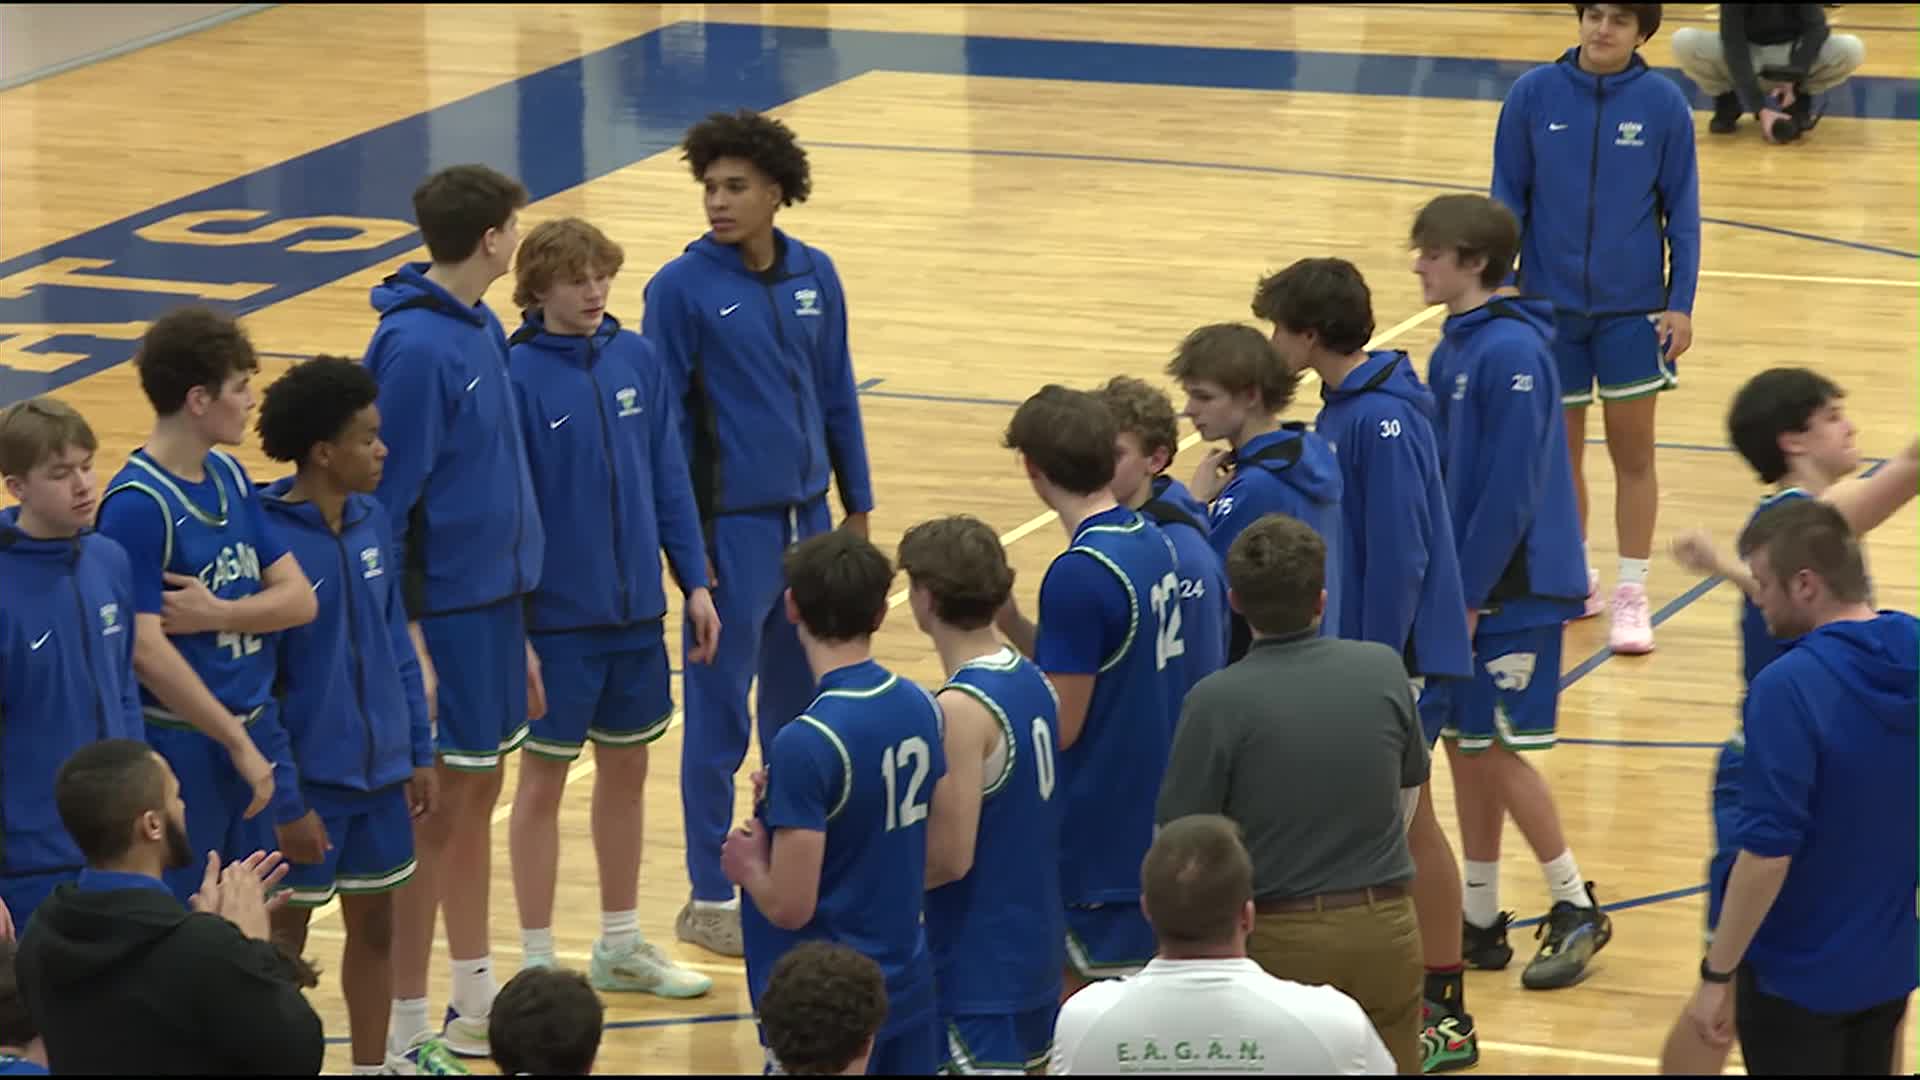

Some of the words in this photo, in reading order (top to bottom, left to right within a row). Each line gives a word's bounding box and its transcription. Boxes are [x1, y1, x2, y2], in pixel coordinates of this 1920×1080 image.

[1380, 419, 1401, 437] 30
[1180, 579, 1205, 598] 24
[882, 736, 930, 831] 12
[1032, 716, 1056, 800] 0
